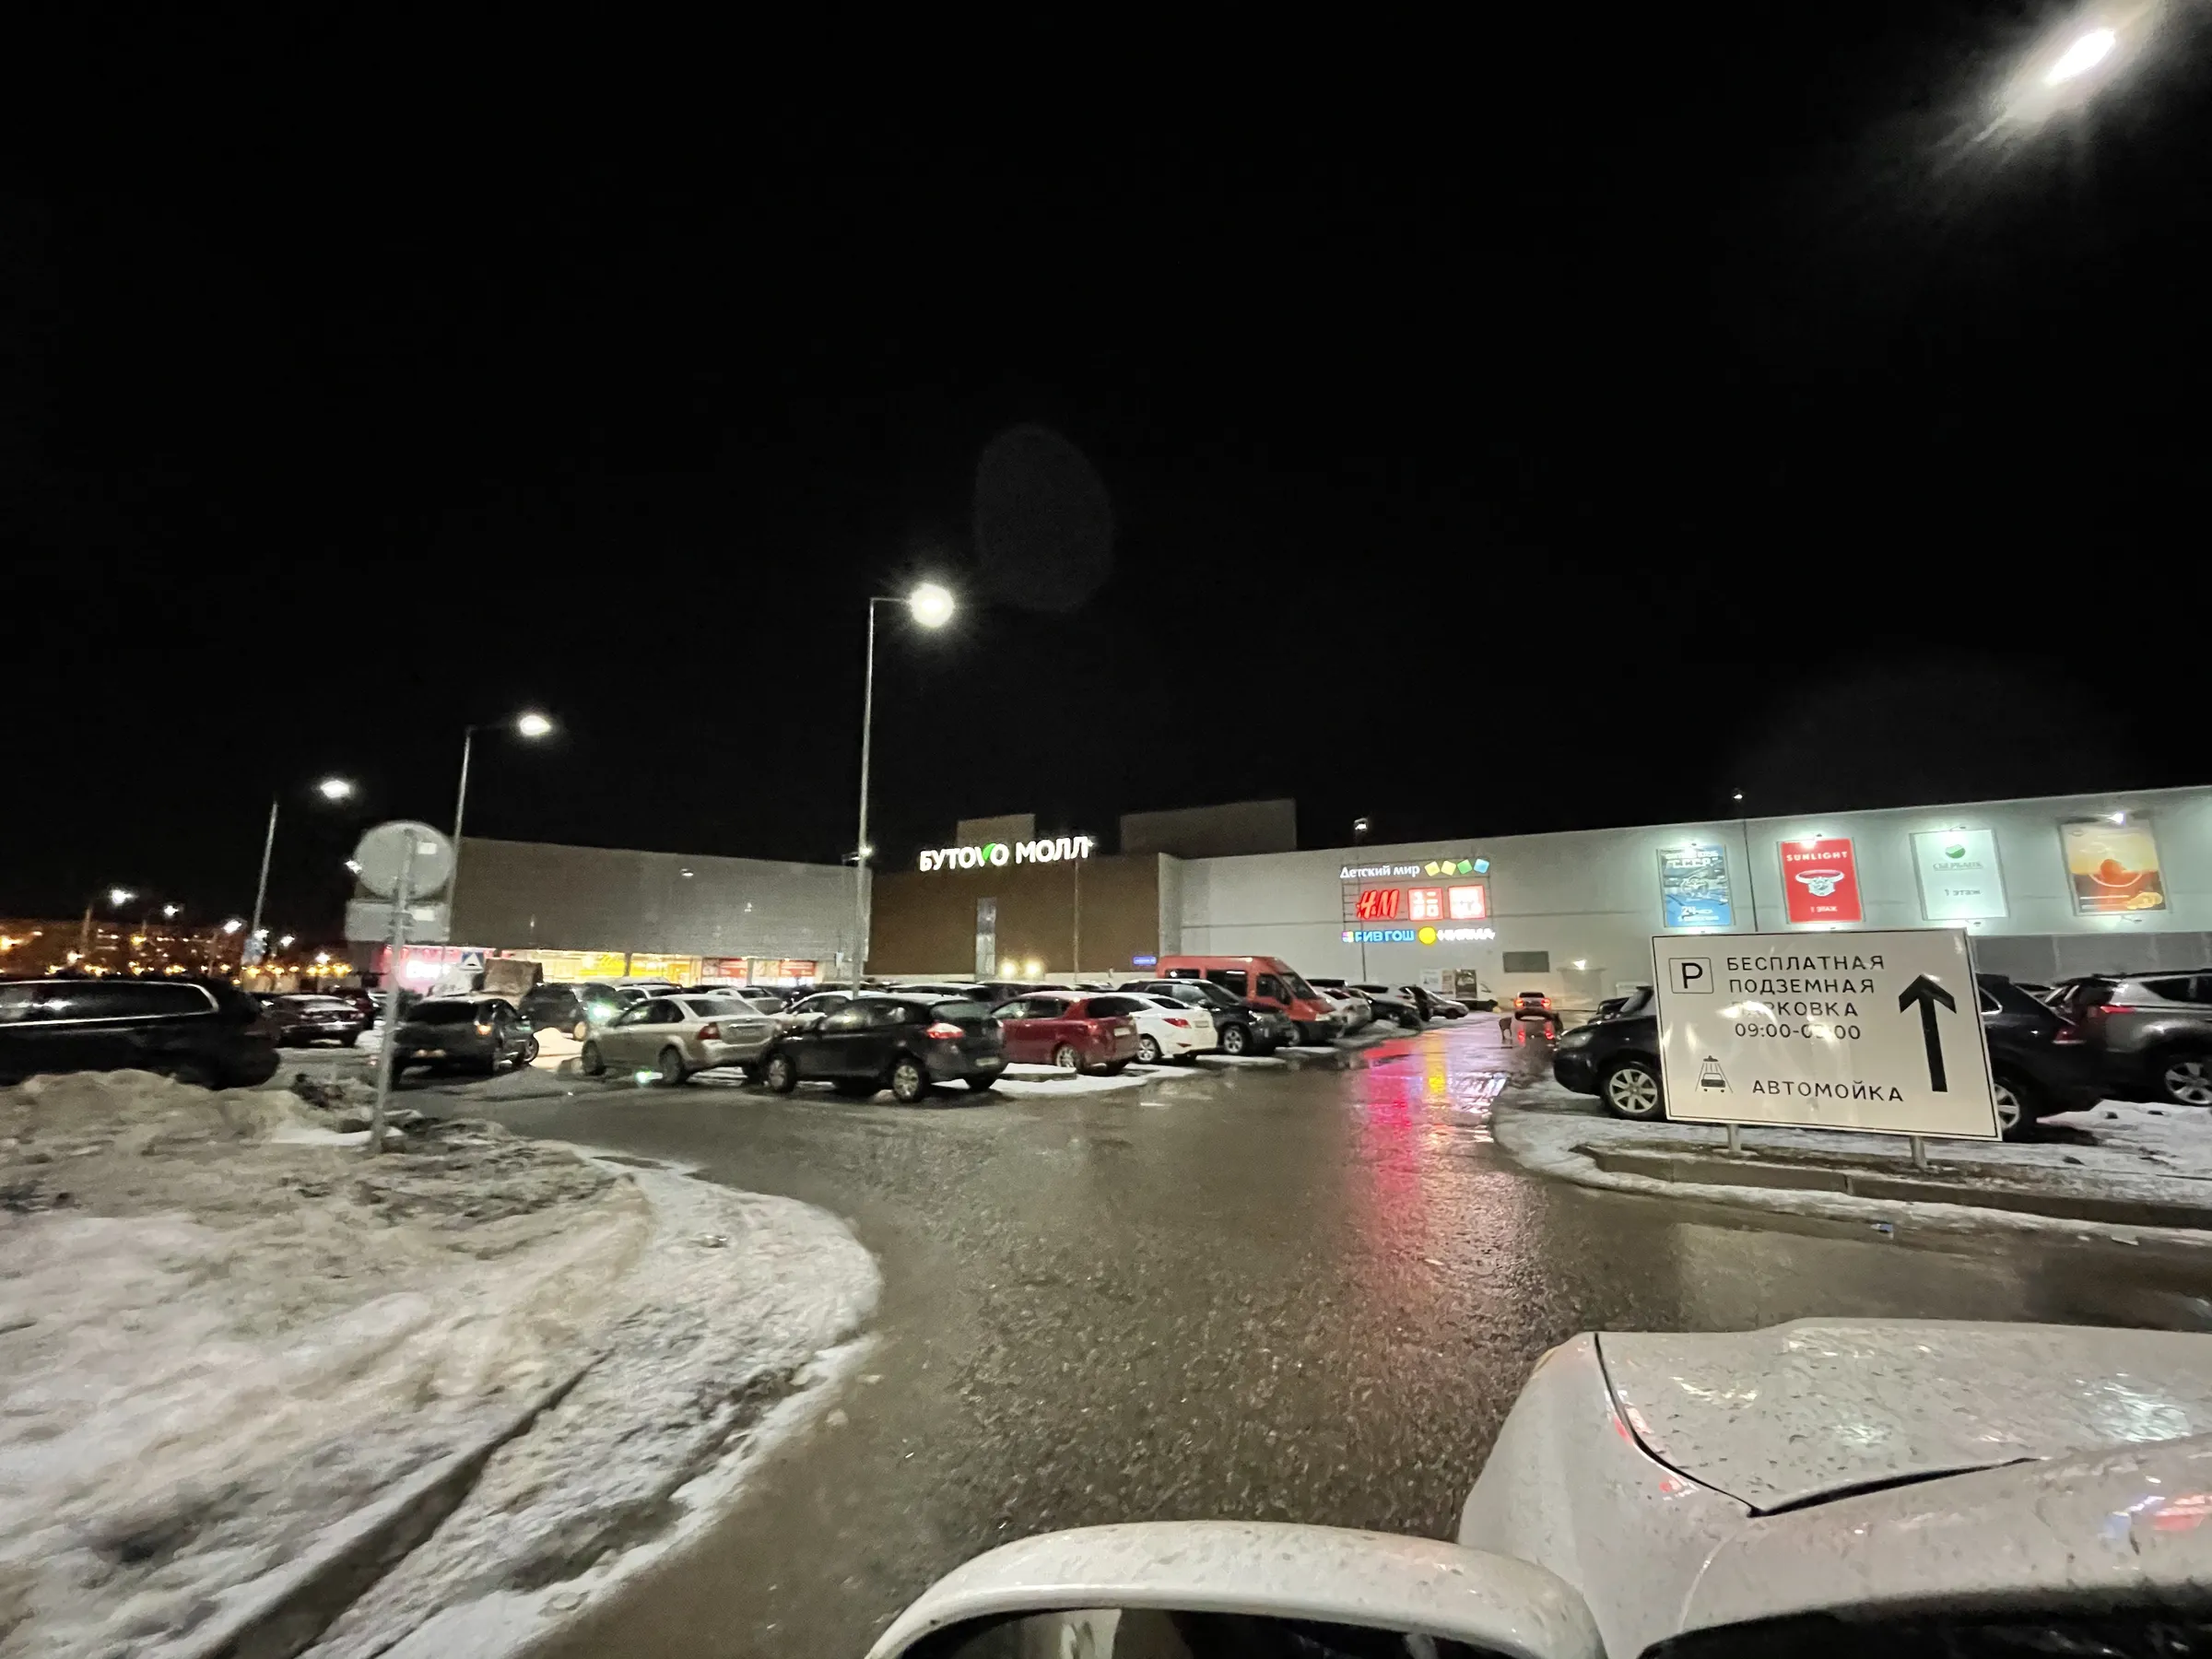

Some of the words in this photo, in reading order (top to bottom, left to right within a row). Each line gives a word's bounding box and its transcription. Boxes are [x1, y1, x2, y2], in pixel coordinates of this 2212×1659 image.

[1016, 836, 1088, 864] МОЛЛ
[1786, 851, 1848, 862] SUNLIGHT
[1340, 865, 1391, 878] Детский
[1394, 865, 1420, 877] мир
[1356, 888, 1399, 920] H&M
[1384, 930, 1416, 941] ГОШ
[1726, 955, 1885, 971] БЕСПЛАТНАЯ
[1729, 979, 1875, 994] ПОДЗЕМНАЯ
[1752, 1079, 1904, 1102] АВТОМОЙКА
